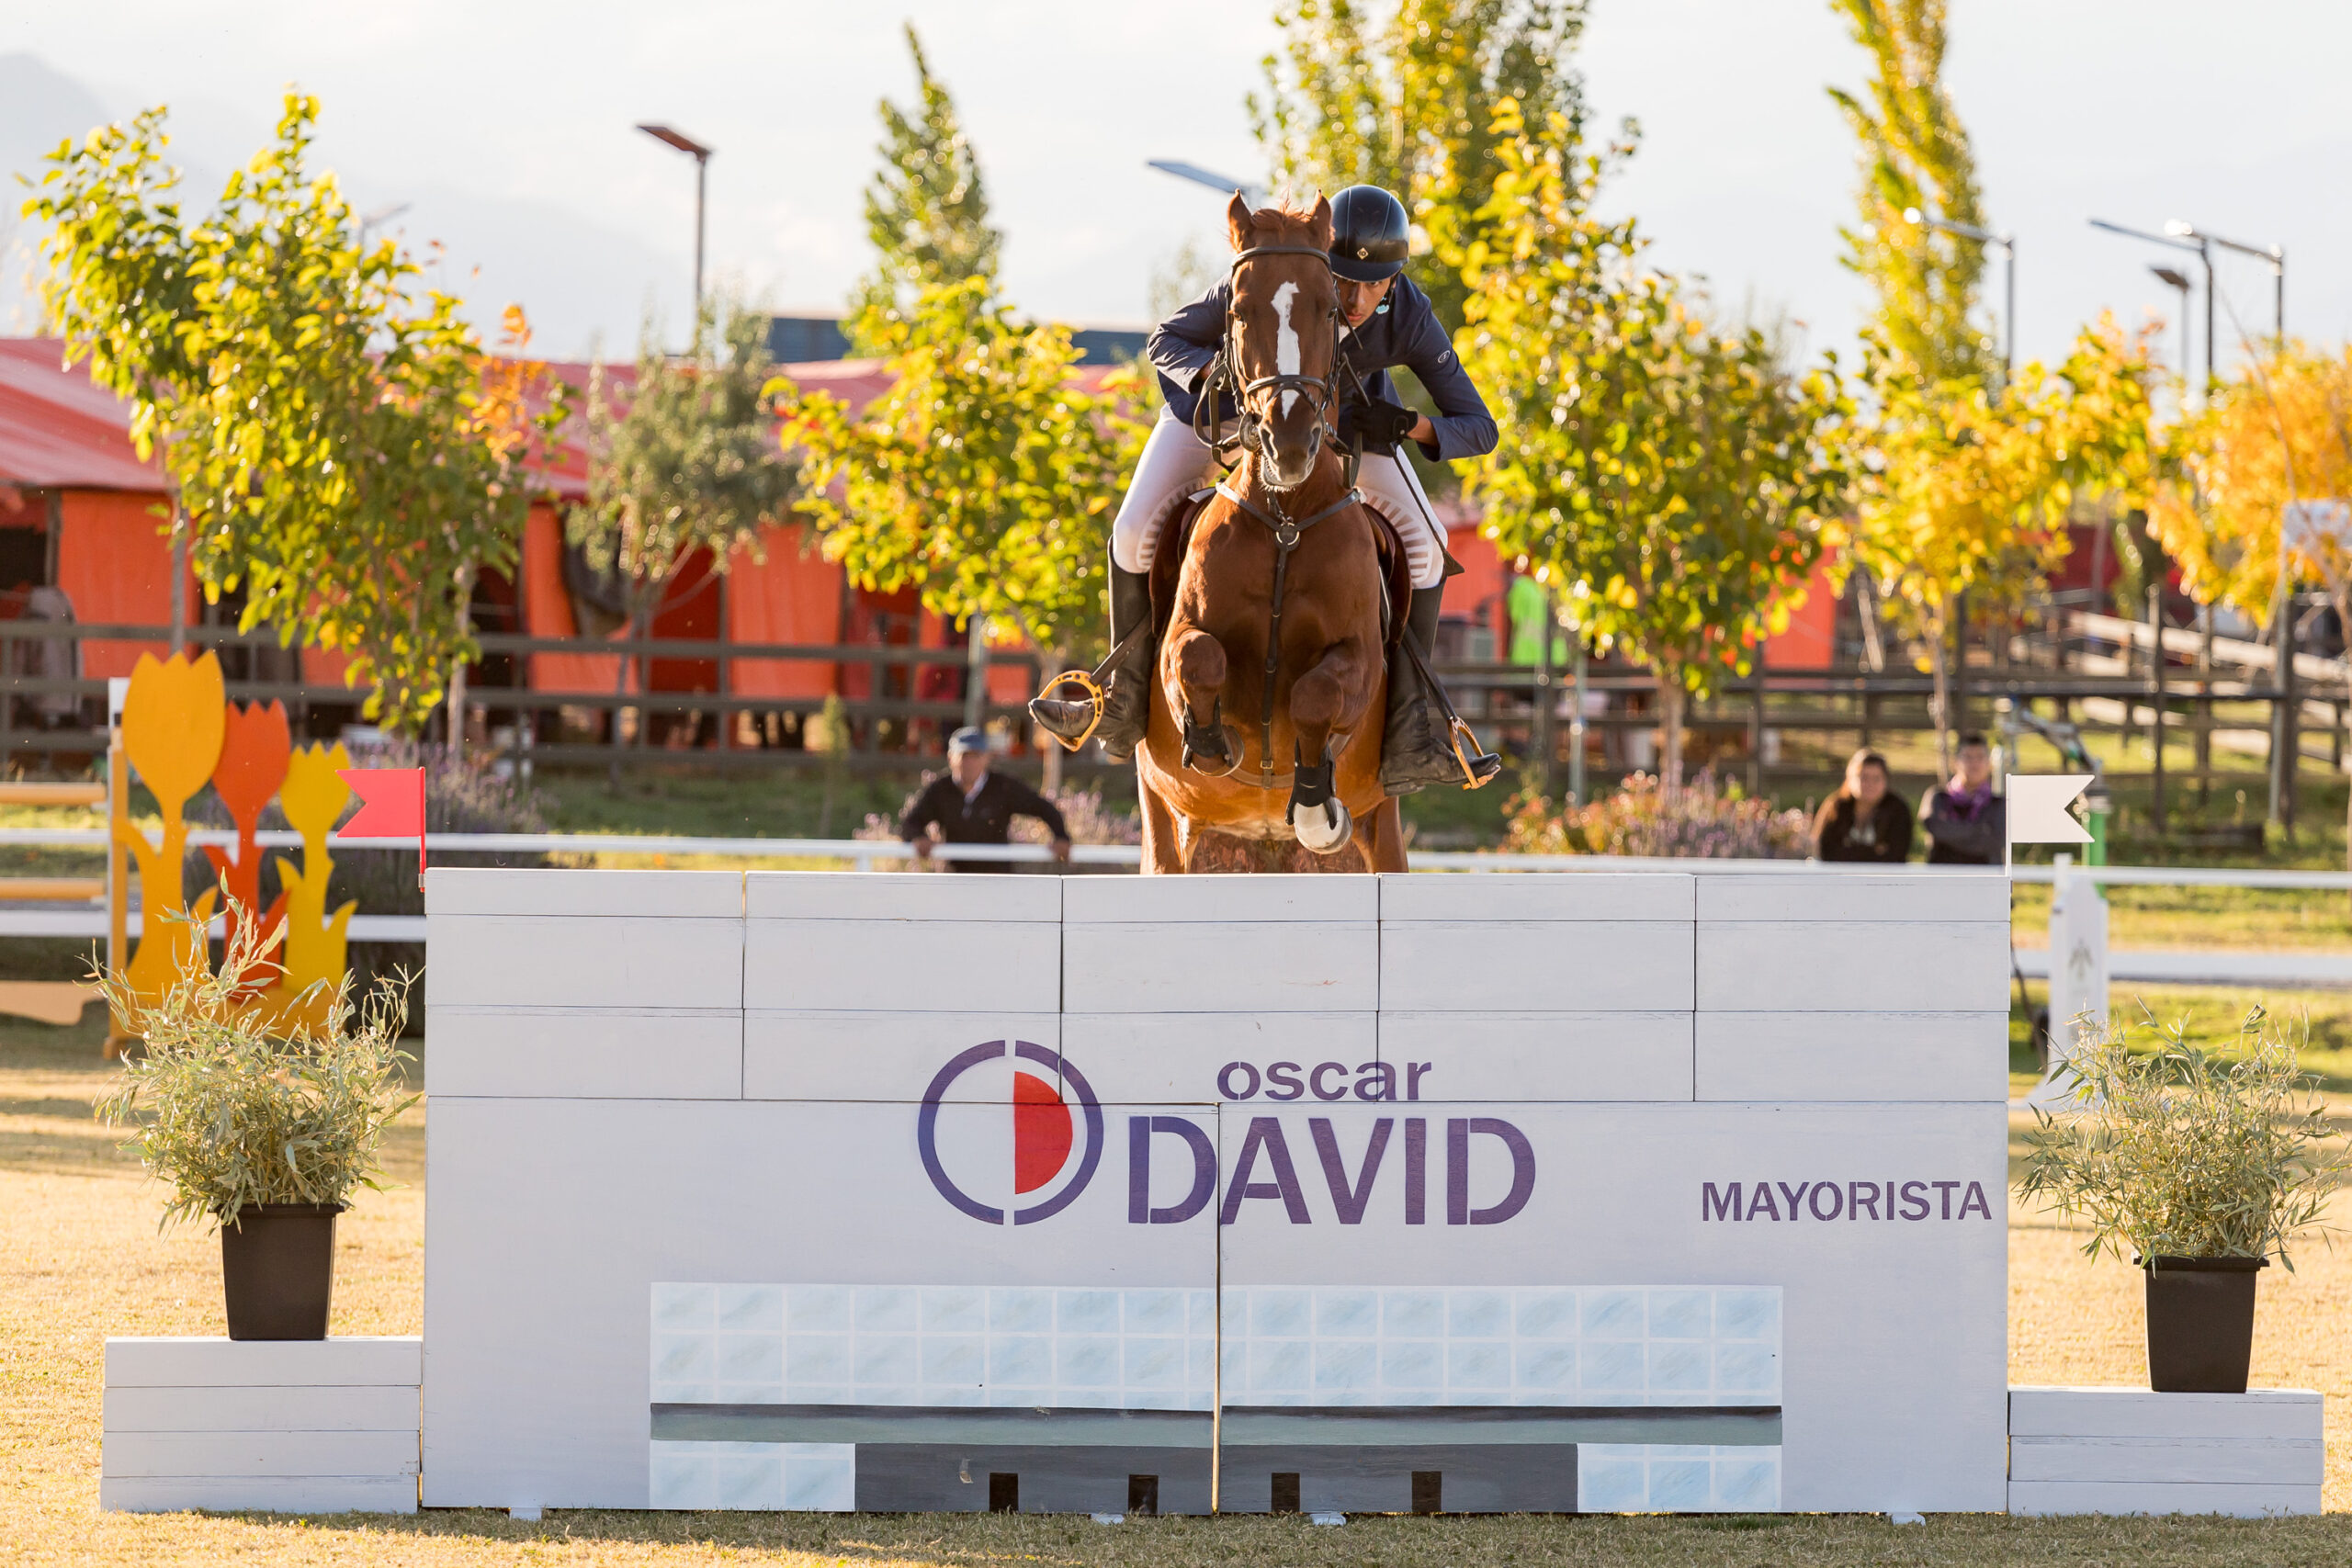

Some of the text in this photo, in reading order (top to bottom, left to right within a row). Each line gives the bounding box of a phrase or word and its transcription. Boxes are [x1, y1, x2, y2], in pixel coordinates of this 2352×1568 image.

[1216, 1061, 1432, 1101] oscar
[1127, 1115, 1536, 1225] DAVID
[1702, 1180, 1992, 1222] MAYORISTA
